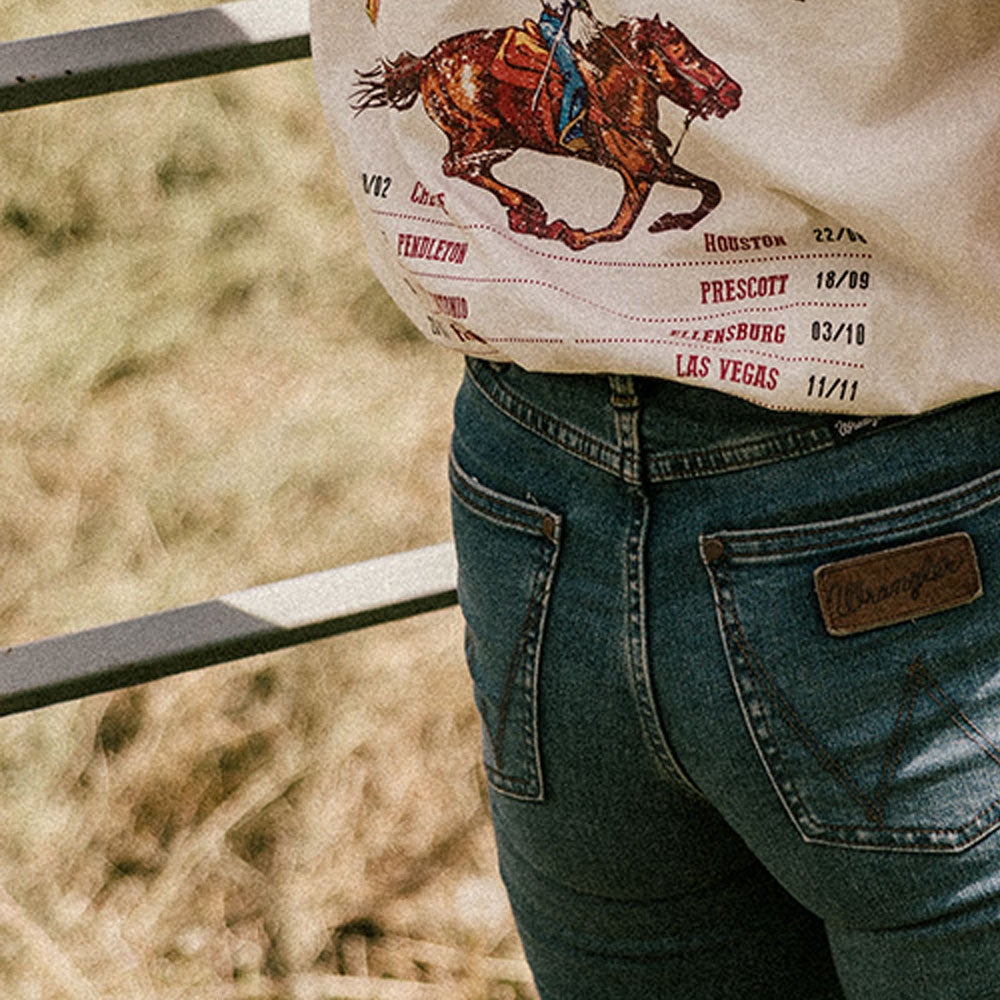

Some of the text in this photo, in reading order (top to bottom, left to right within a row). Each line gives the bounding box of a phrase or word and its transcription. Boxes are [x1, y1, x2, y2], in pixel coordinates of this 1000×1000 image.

[397, 232, 468, 264] PENDLETON
[703, 232, 787, 253] HOUSTON
[700, 270, 870, 305] PRESCOTT 18/09
[811, 320, 865, 346] 03/10
[676, 353, 859, 401] LAS VEGAS 11/11
[828, 556, 964, 617] Wrangler
